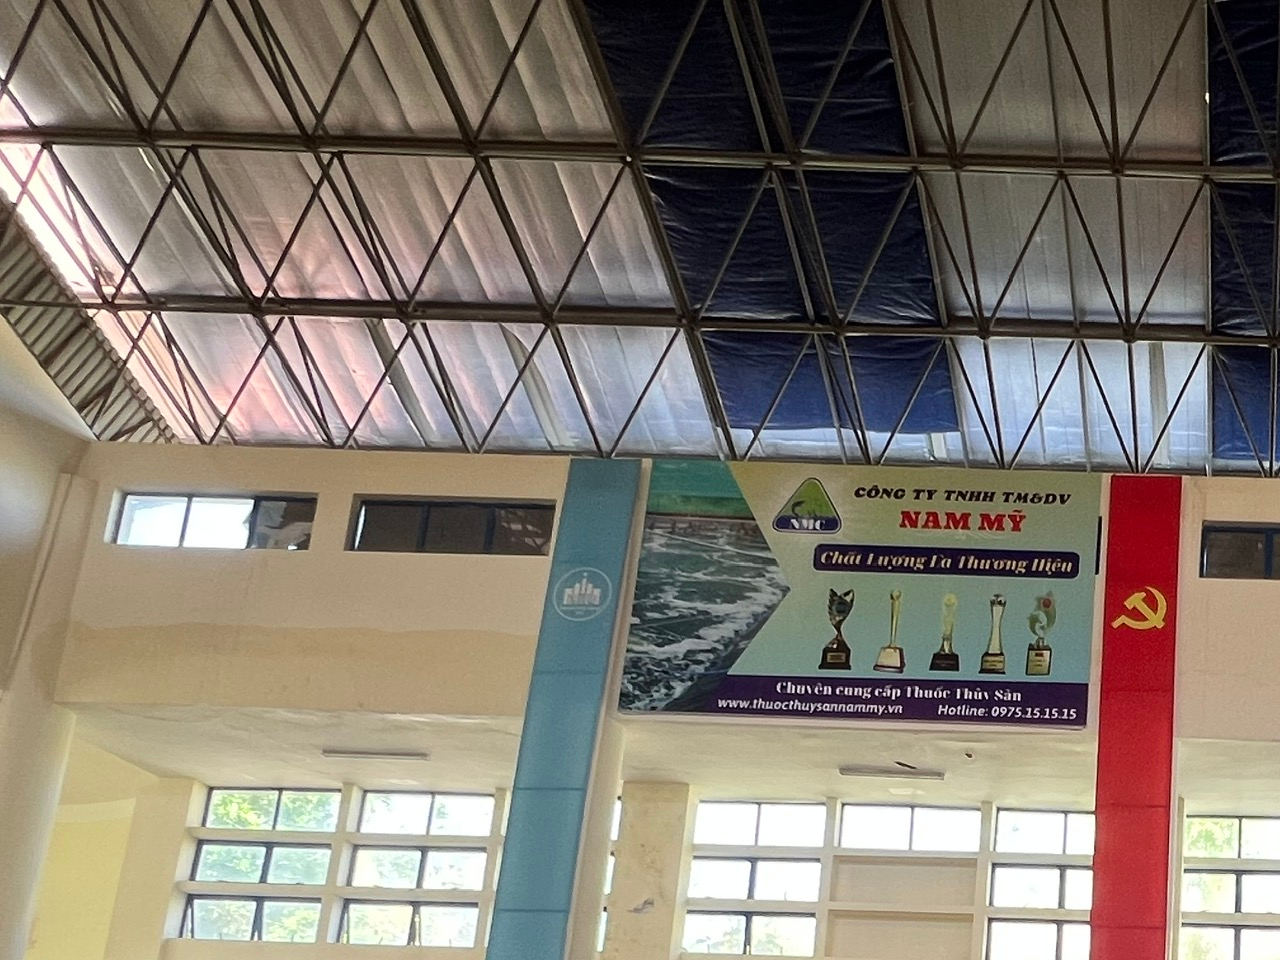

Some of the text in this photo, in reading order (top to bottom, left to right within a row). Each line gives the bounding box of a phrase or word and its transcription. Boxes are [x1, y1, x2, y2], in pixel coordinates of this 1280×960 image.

[853, 486, 1072, 506] CÔNG TY TNHH TM&DV
[898, 508, 1027, 533] NAM MỸ
[776, 681, 832, 697] Chuyên
[834, 685, 872, 700] cung
[873, 682, 901, 700] cấp
[717, 697, 904, 716] www.thuocthuysannammy.vn
[937, 704, 1077, 720] Hotline: 0975.15.15.15
